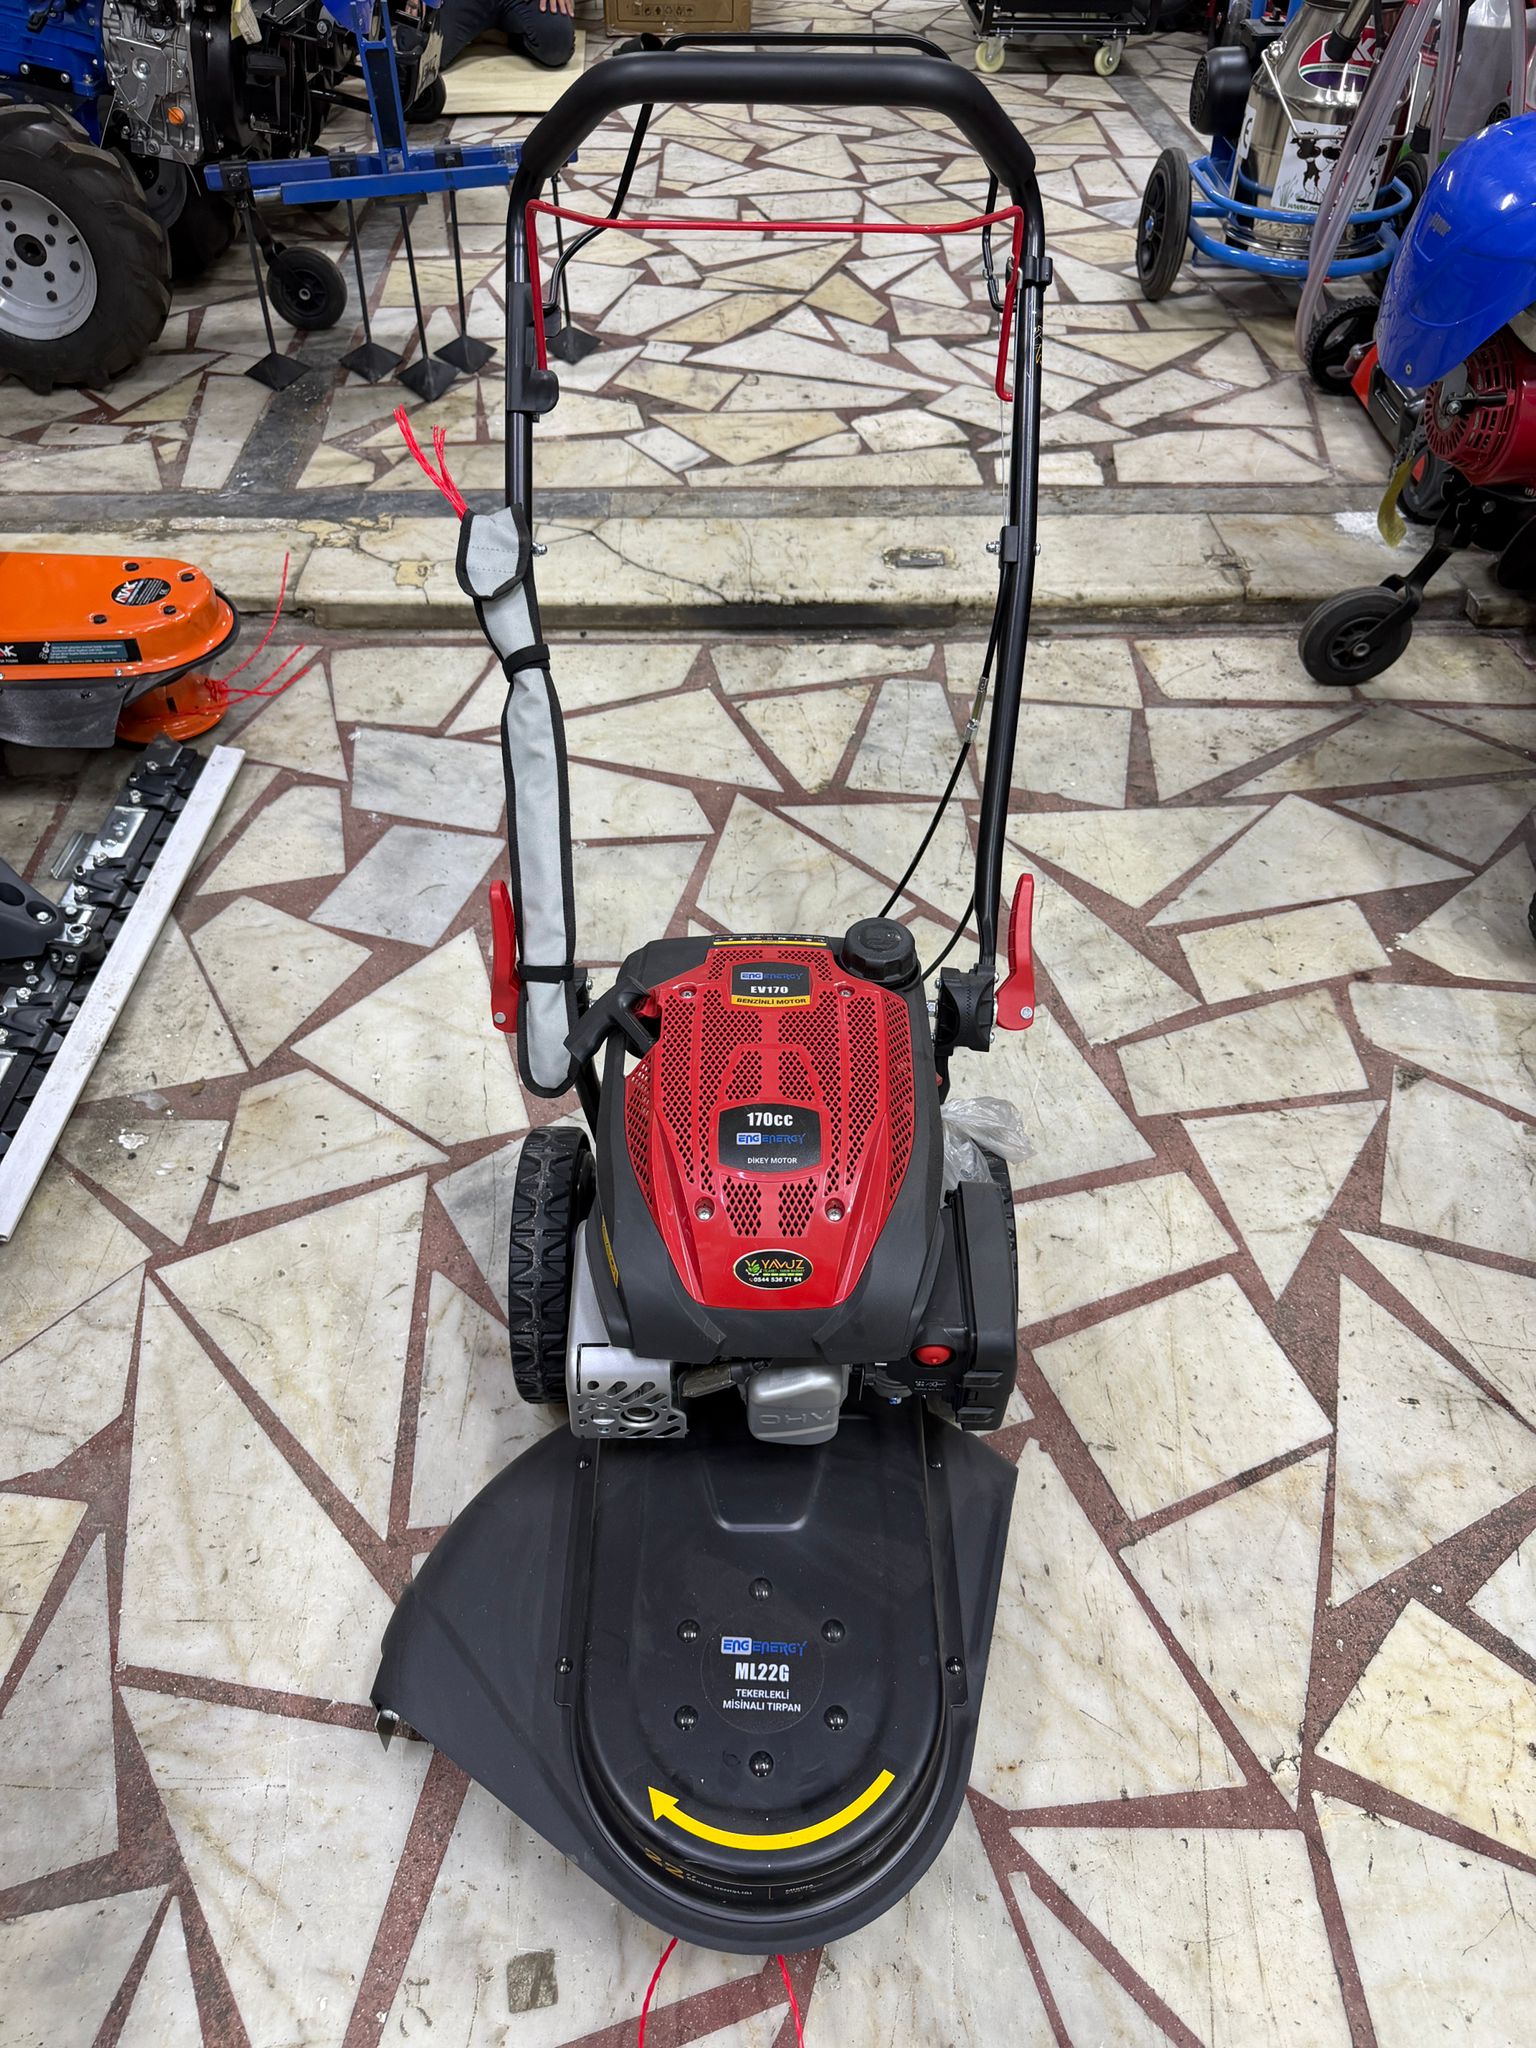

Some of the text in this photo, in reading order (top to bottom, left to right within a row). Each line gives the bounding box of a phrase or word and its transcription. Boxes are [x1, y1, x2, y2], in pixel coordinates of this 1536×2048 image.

[750, 986, 789, 994] EV170
[747, 1112, 793, 1126] 170cc
[761, 1259, 805, 1269] YAVUZ
[760, 1409, 831, 1424] OHV
[734, 1662, 790, 1682] ML22G
[736, 1688, 790, 1700] TEKERLEKLİ
[767, 1702, 801, 1712] TIRPAN
